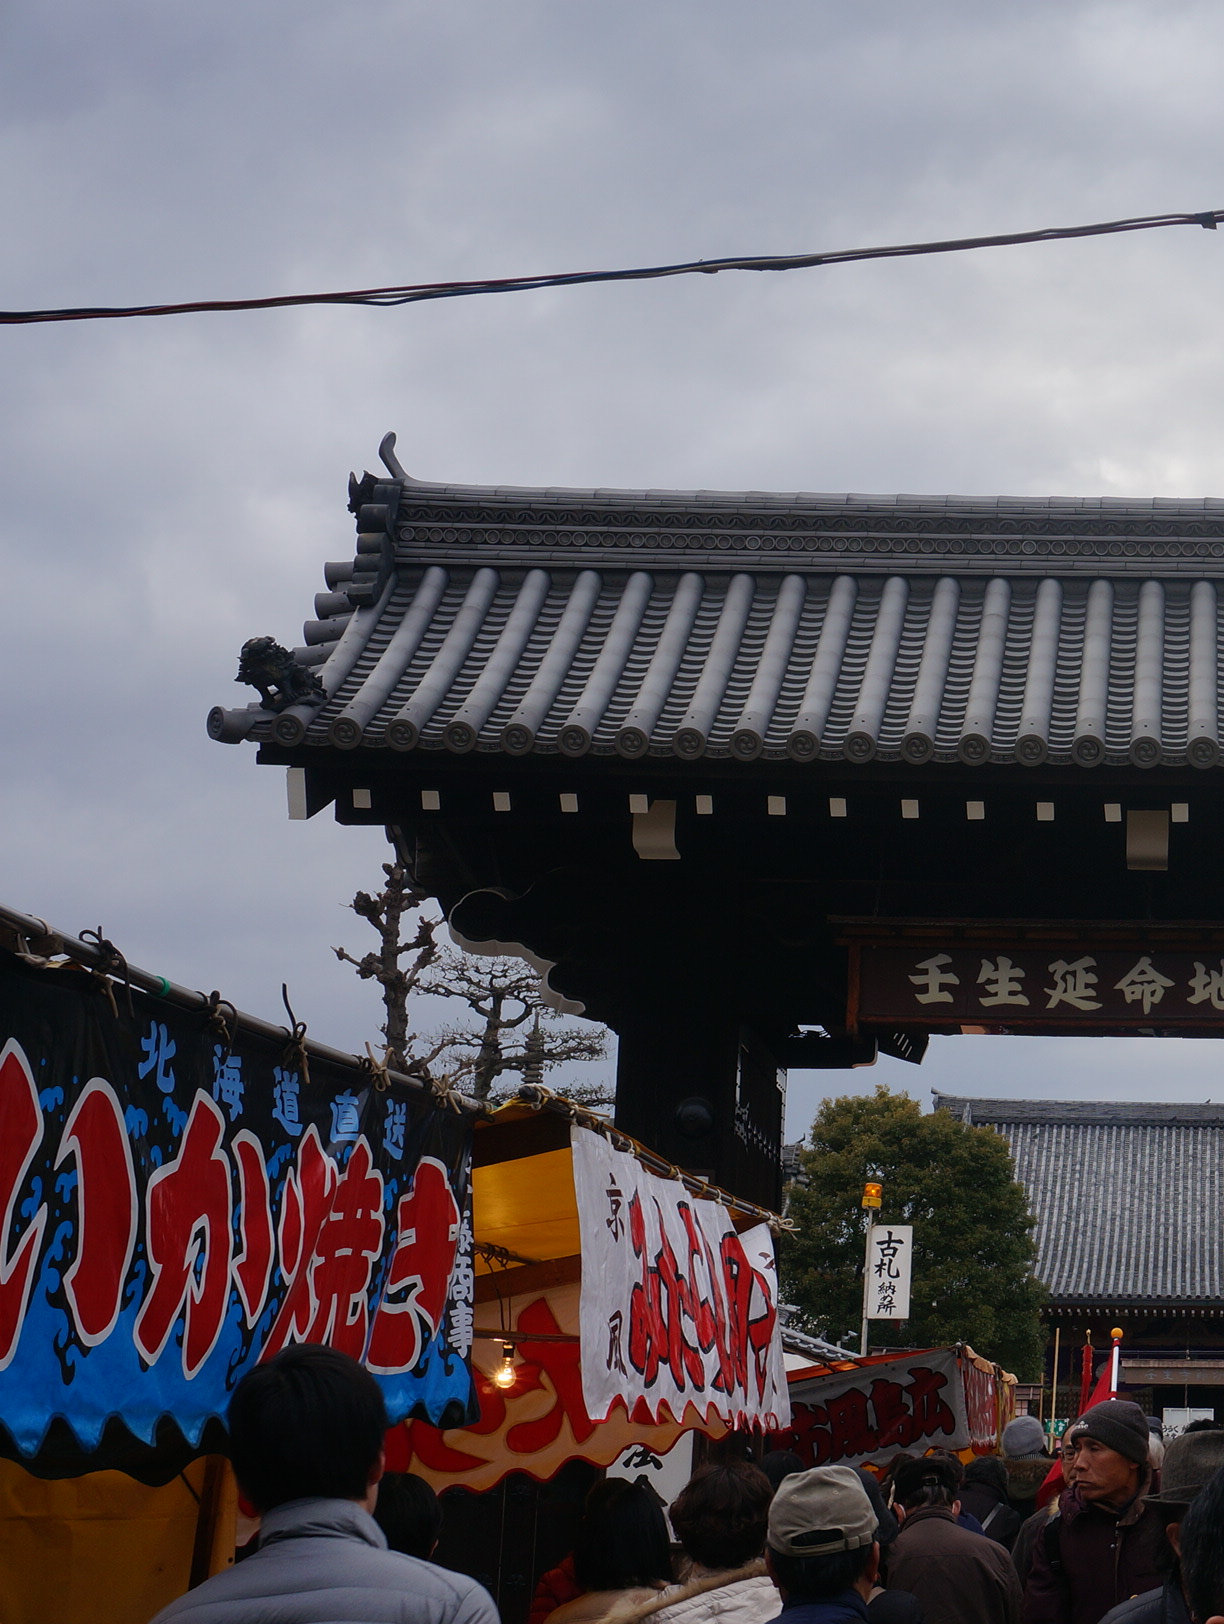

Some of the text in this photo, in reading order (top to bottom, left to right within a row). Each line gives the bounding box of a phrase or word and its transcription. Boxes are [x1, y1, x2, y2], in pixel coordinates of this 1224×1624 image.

[138, 1020, 408, 1160] 北海道直送
[0, 1037, 461, 1381] いか焼き
[605, 1172, 629, 1379] 京風
